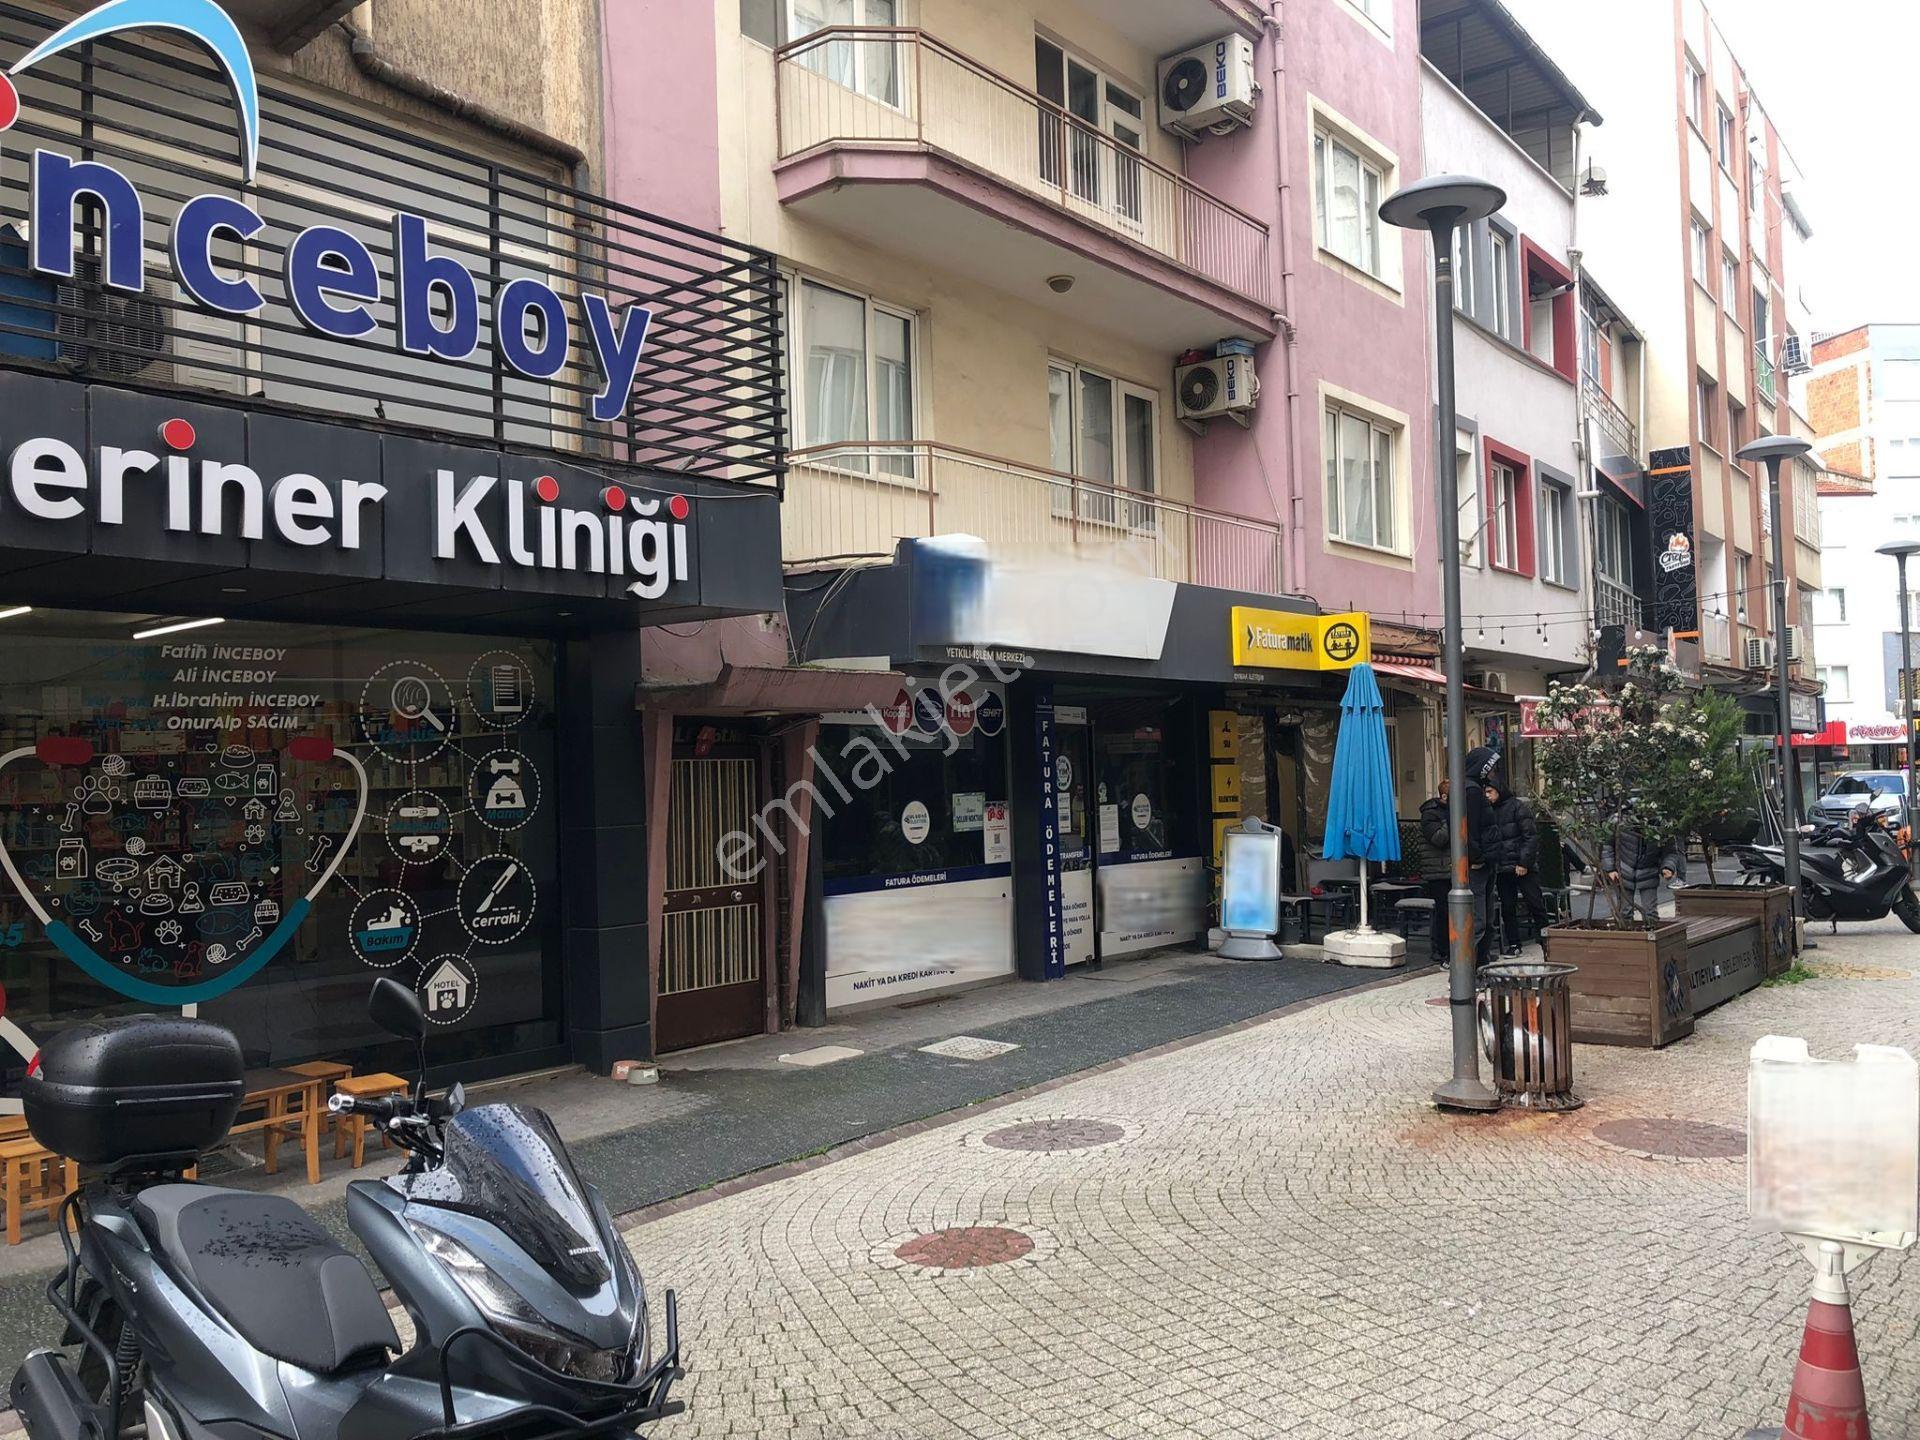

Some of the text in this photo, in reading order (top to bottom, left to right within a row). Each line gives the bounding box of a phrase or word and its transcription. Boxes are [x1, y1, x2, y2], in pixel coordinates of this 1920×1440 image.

[1215, 41, 1227, 99] BEKO
[30, 147, 652, 422] nceboy
[1226, 359, 1236, 401] BEKO
[10, 418, 689, 599] eriner Kliniği
[1255, 626, 1313, 653] Faturamatik
[161, 643, 207, 661] Fatih
[212, 643, 287, 661] İNCEBOY
[946, 646, 972, 659] YETKİLİ
[996, 650, 1026, 663] MERKEZİ
[173, 667, 199, 683] Ali
[202, 666, 277, 683] İNCEBOY
[153, 691, 244, 708] H.İbrahim
[248, 691, 321, 708] İNCEBOY
[951, 697, 971, 718] ria
[247, 712, 299, 730] SAĞIM
[1041, 720, 1053, 809] FATURA
[885, 871, 947, 887] FATURA ÖDEMELERİ
[1045, 824, 1058, 964] ÖDEMELERİ
[433, 980, 461, 990] HOTEL
[853, 977, 876, 991] NAKİT
[876, 977, 887, 986] YA
[887, 974, 897, 984] DA
[898, 969, 919, 982] KREDİ
[568, 1246, 599, 1256] HONDA
